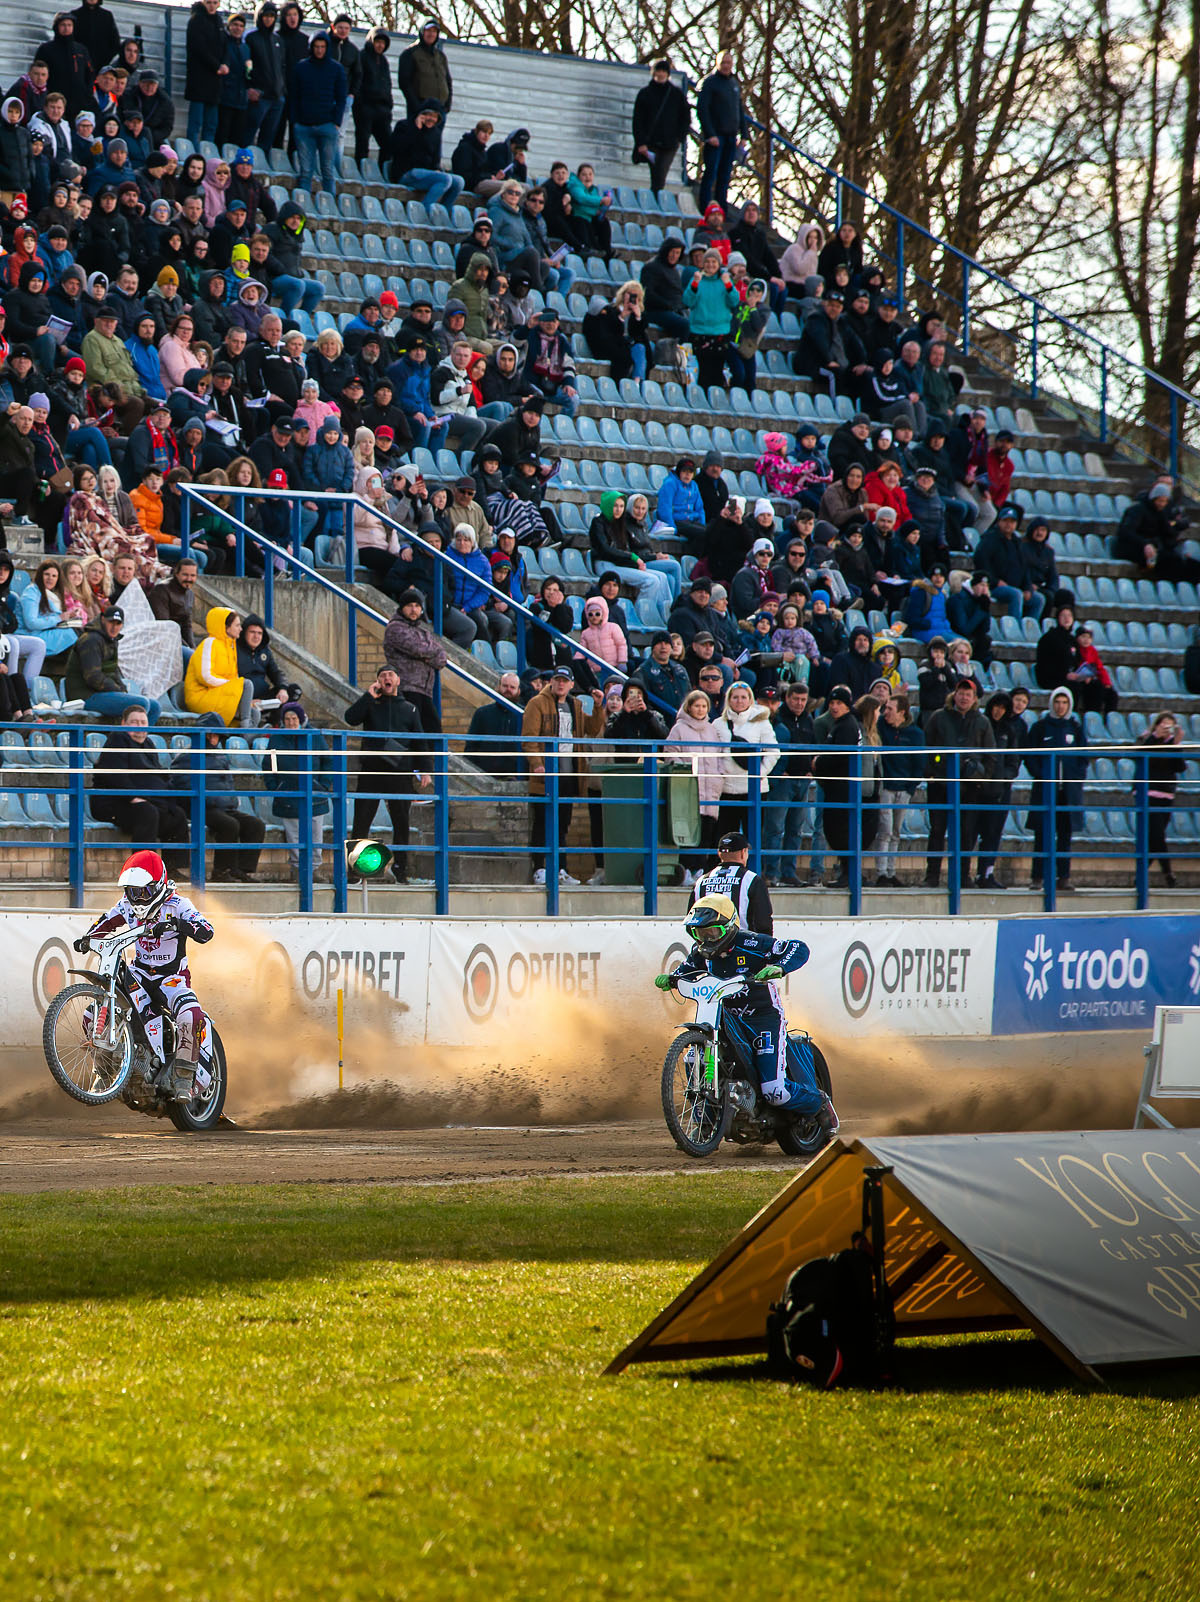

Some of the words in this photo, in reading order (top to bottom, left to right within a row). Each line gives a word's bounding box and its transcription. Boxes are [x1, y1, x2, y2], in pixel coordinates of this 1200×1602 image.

[705, 884, 732, 893] STARTU
[142, 952, 172, 962] OPTIBET
[302, 950, 405, 1000] OPTIBET
[507, 951, 602, 999] OPTIBET
[881, 948, 971, 994] OPTIBET
[1057, 938, 1150, 990] trodo
[1059, 1002, 1078, 1019] CAR
[1079, 1001, 1109, 1018] PARTS
[1110, 1000, 1146, 1017] ONLINE
